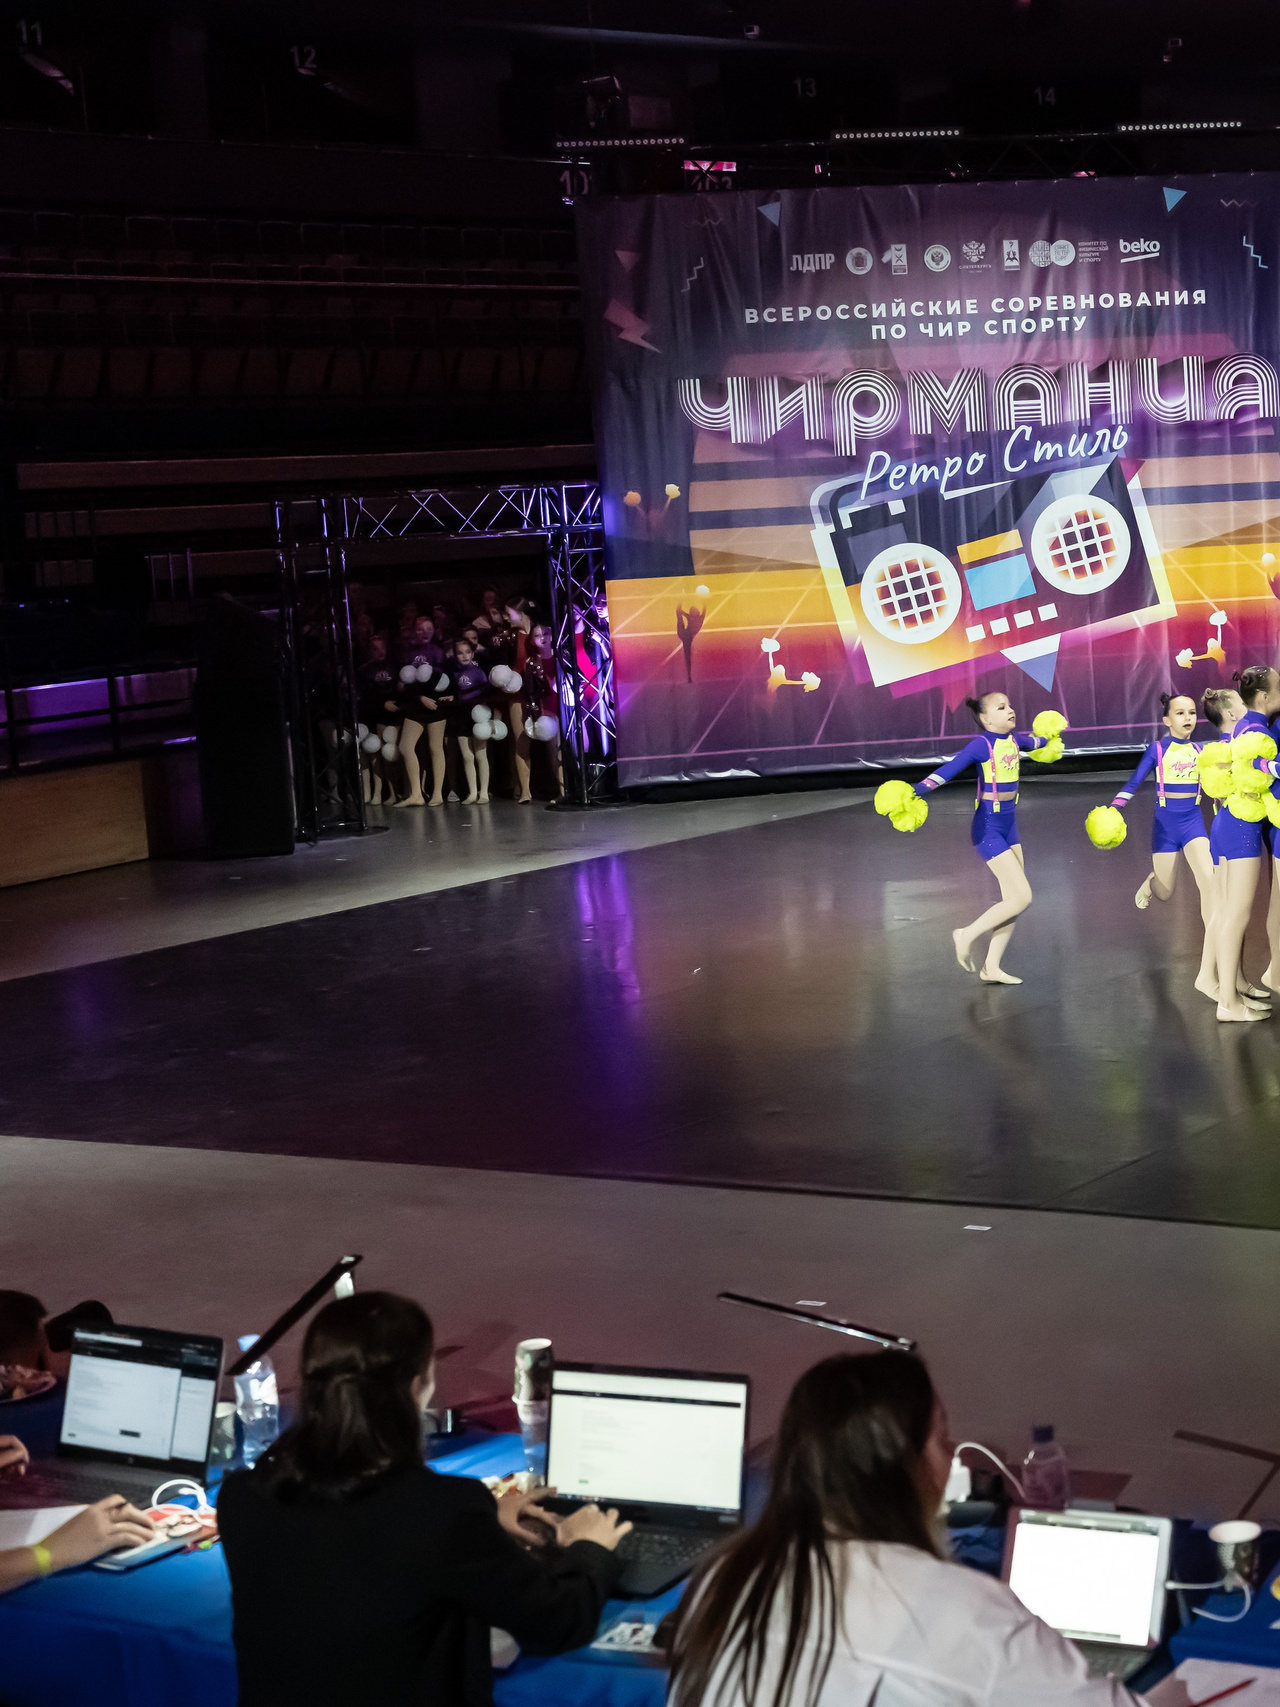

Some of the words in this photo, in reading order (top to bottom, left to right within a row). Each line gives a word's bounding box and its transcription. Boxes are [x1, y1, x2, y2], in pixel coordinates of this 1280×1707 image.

[290, 45, 318, 69] 12
[793, 77, 818, 98] 13
[1034, 85, 1057, 106] 14
[1119, 238, 1160, 254] beko
[790, 253, 835, 273] ЛДПР
[744, 298, 979, 324] ВСЕРОССИЙСКИЕ
[990, 289, 1207, 314] СОРЕВНОВАНИЯ
[871, 324, 908, 341] ПО
[919, 321, 971, 338] ЧИР
[983, 315, 1088, 336] СПОРТУ
[860, 449, 987, 501] Ретро
[1003, 425, 1130, 474] Стиль
